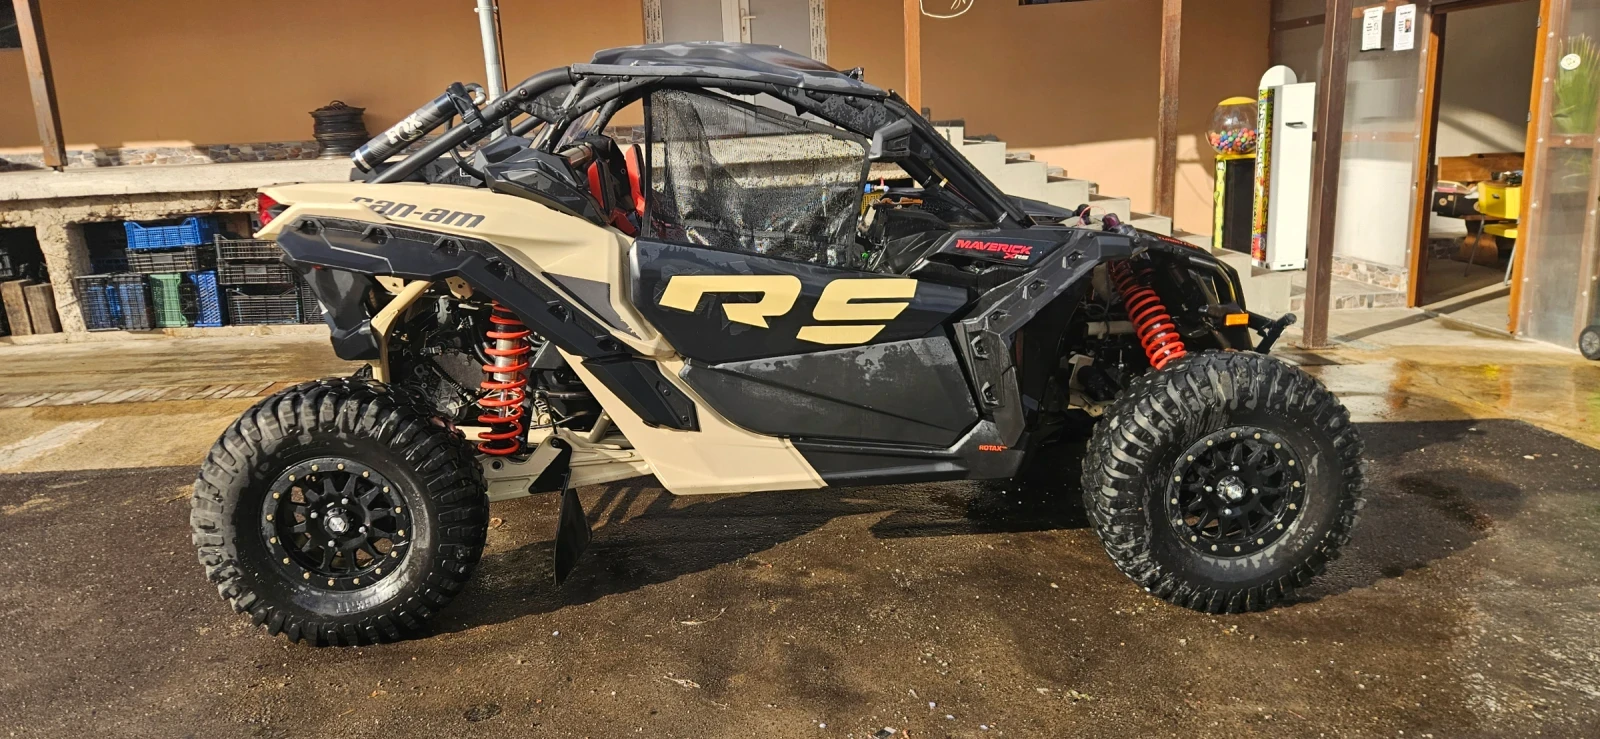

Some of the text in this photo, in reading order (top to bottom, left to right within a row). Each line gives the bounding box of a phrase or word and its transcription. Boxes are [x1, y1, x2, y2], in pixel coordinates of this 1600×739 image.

[385, 113, 423, 144] FOX
[955, 239, 1033, 254] MAVERICK
[658, 275, 918, 345] RS
[978, 444, 1002, 452] ROTAX
